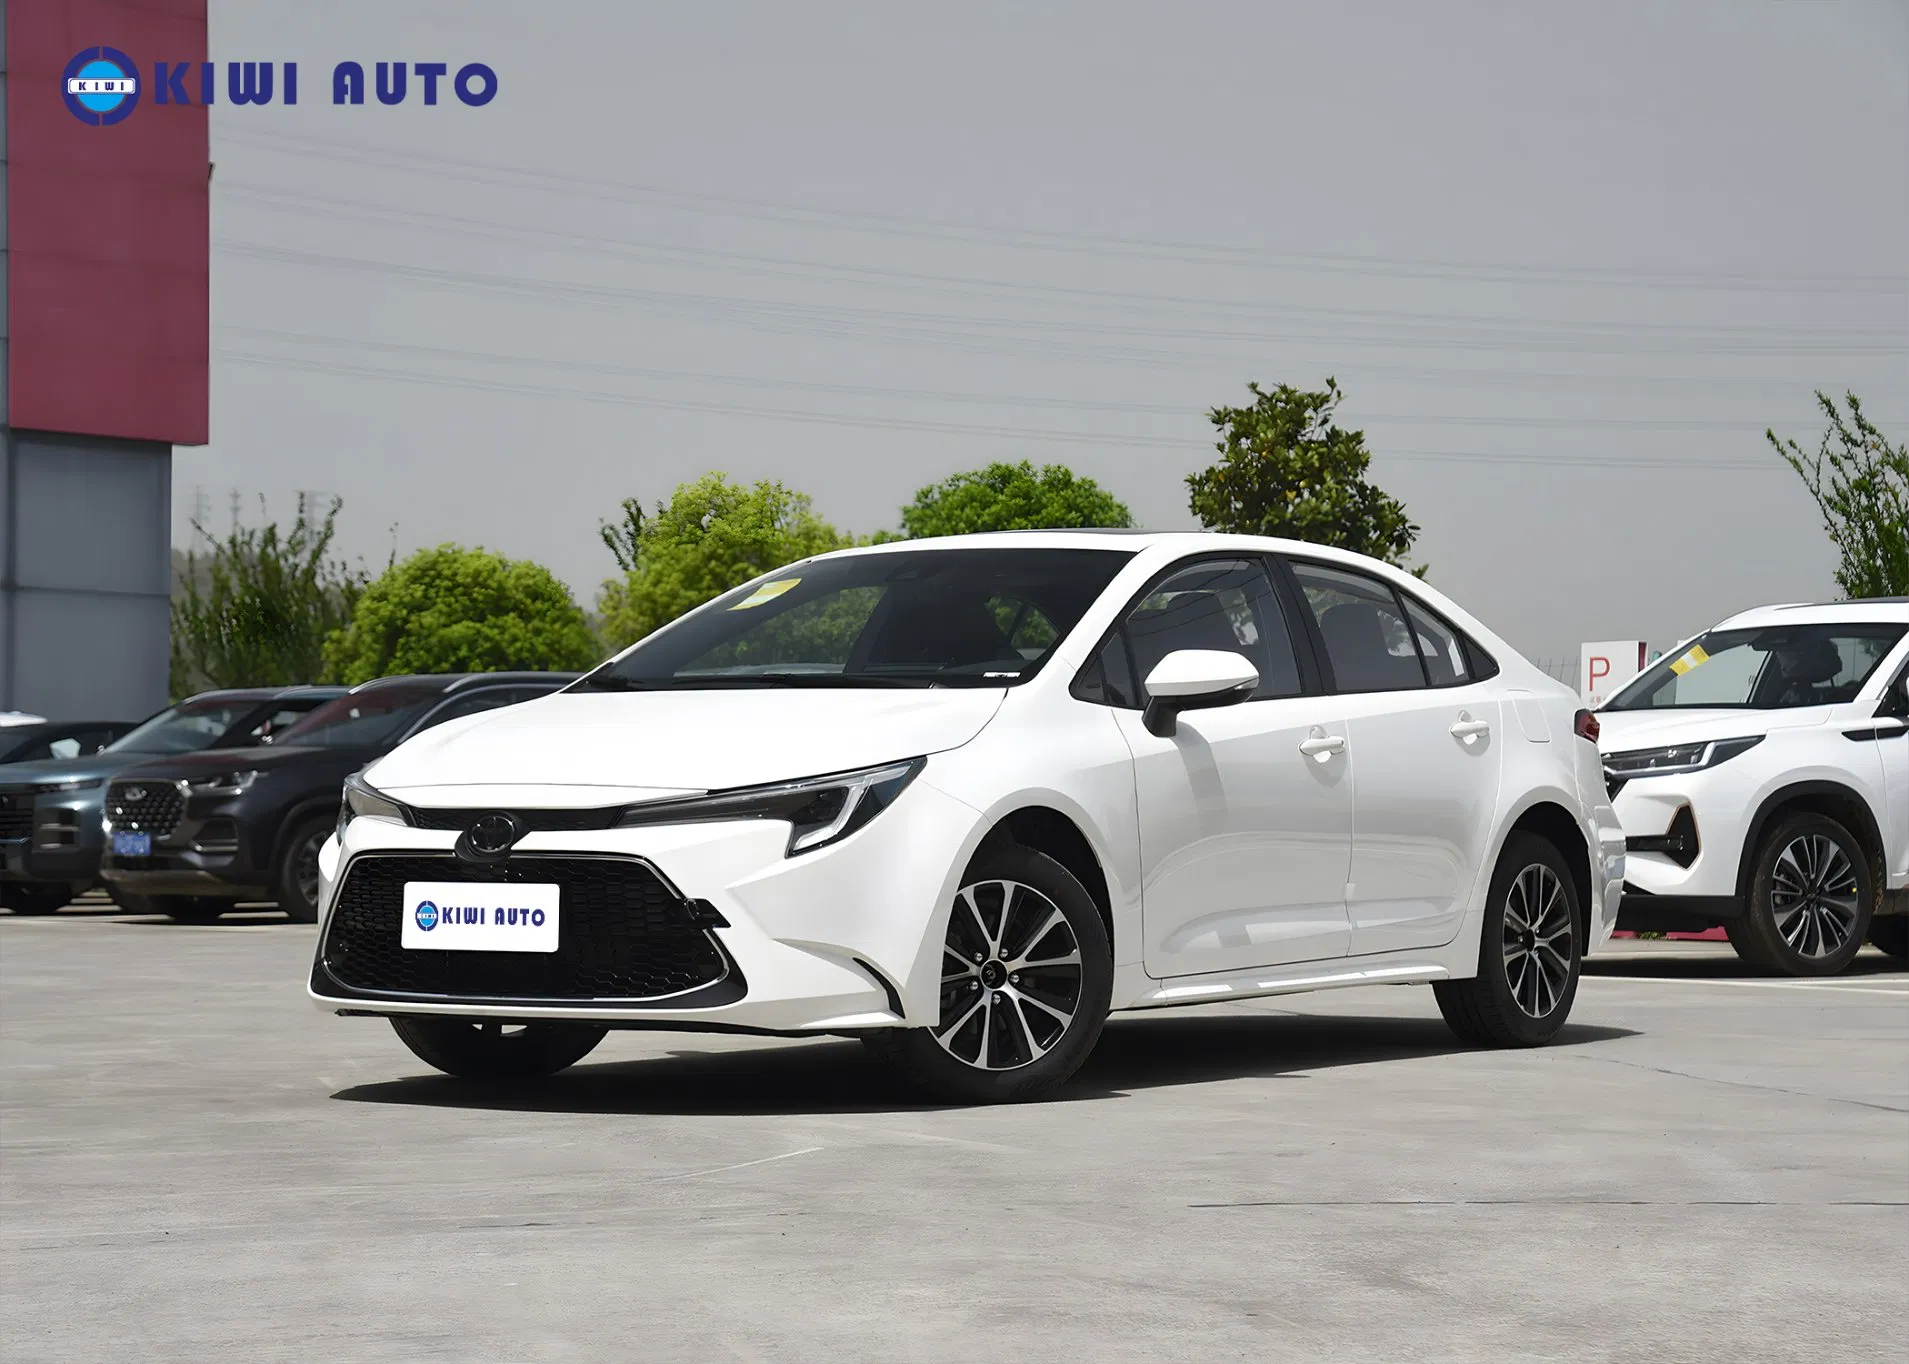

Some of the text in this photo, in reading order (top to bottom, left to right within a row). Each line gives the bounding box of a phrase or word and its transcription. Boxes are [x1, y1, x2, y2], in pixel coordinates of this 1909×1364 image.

[1589, 656, 1611, 691] P
[442, 906, 546, 927] KIWI AUTO
